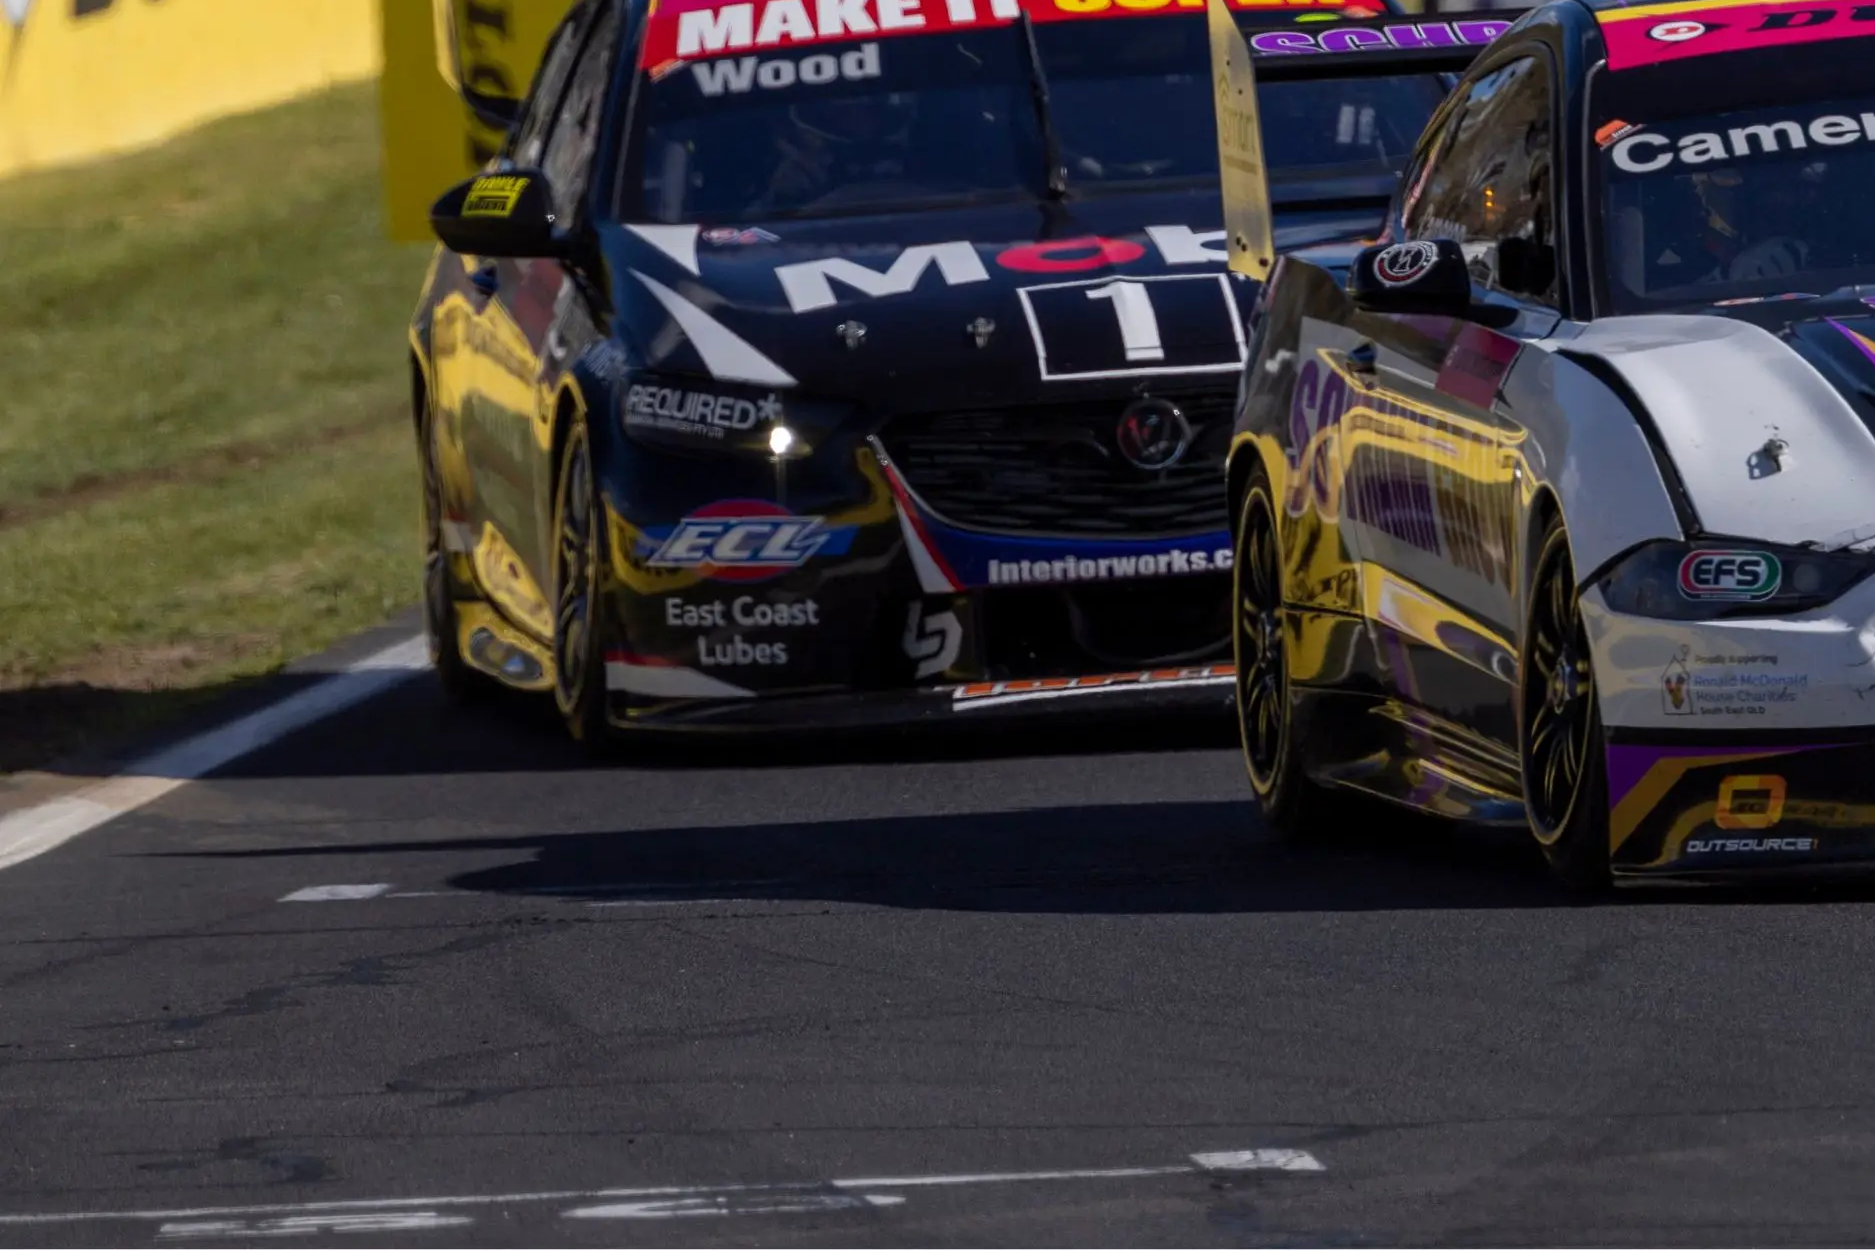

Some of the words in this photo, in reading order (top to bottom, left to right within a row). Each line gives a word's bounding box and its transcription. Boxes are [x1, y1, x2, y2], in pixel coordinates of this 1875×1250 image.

[693, 43, 880, 97] Wood
[1085, 281, 1165, 361] 1
[988, 549, 1234, 584] Interiorworks.c
[1693, 558, 1763, 586] EFS
[665, 597, 726, 627] East
[732, 595, 819, 627] Coast
[698, 634, 788, 666] Lubes
